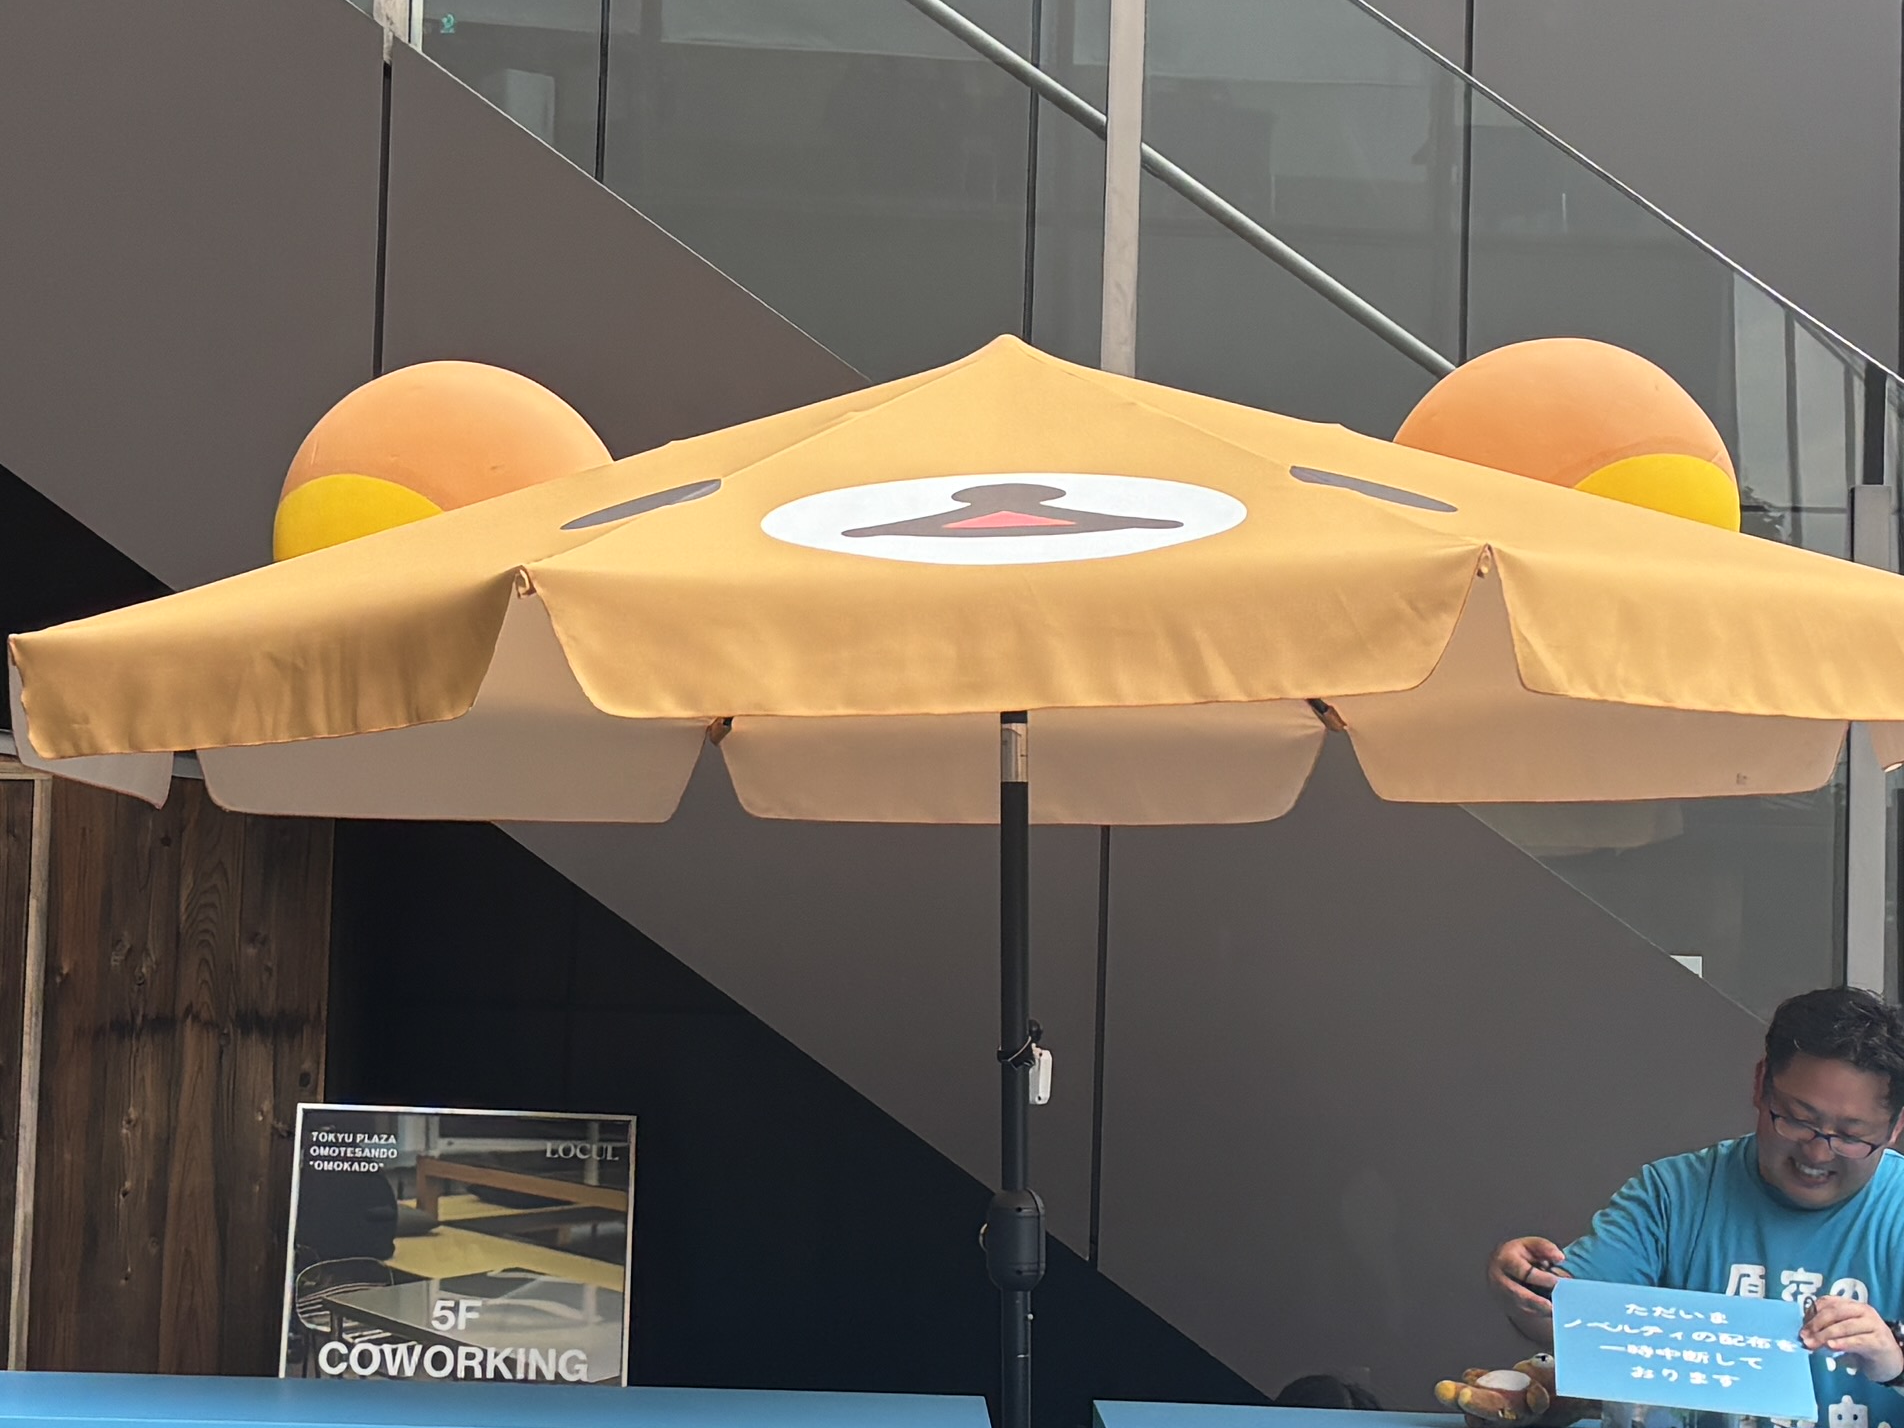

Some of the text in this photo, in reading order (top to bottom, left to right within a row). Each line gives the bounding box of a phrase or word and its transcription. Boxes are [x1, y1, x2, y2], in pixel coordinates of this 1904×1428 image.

[311, 1131, 397, 1144] TOKYU PLAZA
[309, 1145, 398, 1159] OMOTESANDO
[545, 1142, 619, 1160] LOCUL
[431, 1299, 482, 1331] 5F
[1625, 1303, 1728, 1325] ただいま
[1564, 1318, 1798, 1353] ノベルティの配布を
[318, 1341, 588, 1383] COWORKING
[1599, 1344, 1763, 1370] 一時中断して
[1631, 1365, 1740, 1388] おります
